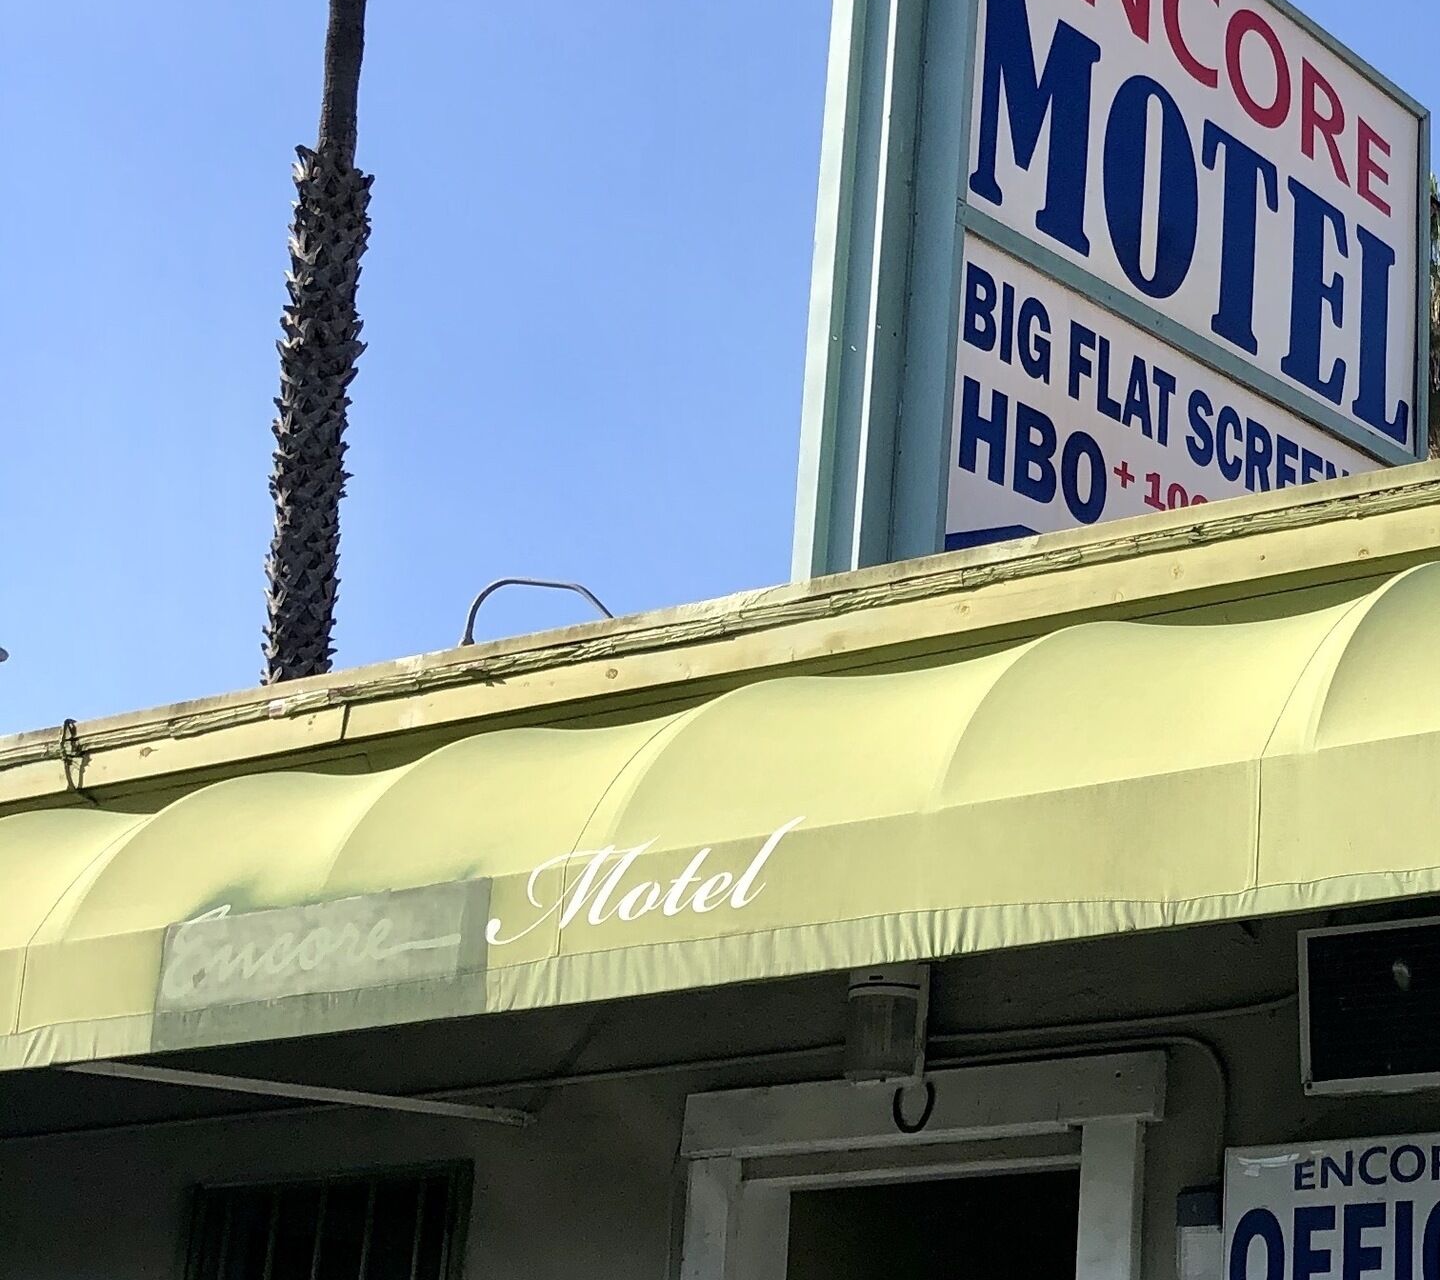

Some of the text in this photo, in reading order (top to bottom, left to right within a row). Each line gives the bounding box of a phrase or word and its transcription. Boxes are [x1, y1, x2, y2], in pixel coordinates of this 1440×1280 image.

[962, 261, 1051, 386] BIG
[1067, 322, 1177, 448] FLAT
[957, 376, 1108, 525] HBO
[1143, 471, 1209, 512] 10
[161, 815, 806, 999] Encore Motel
